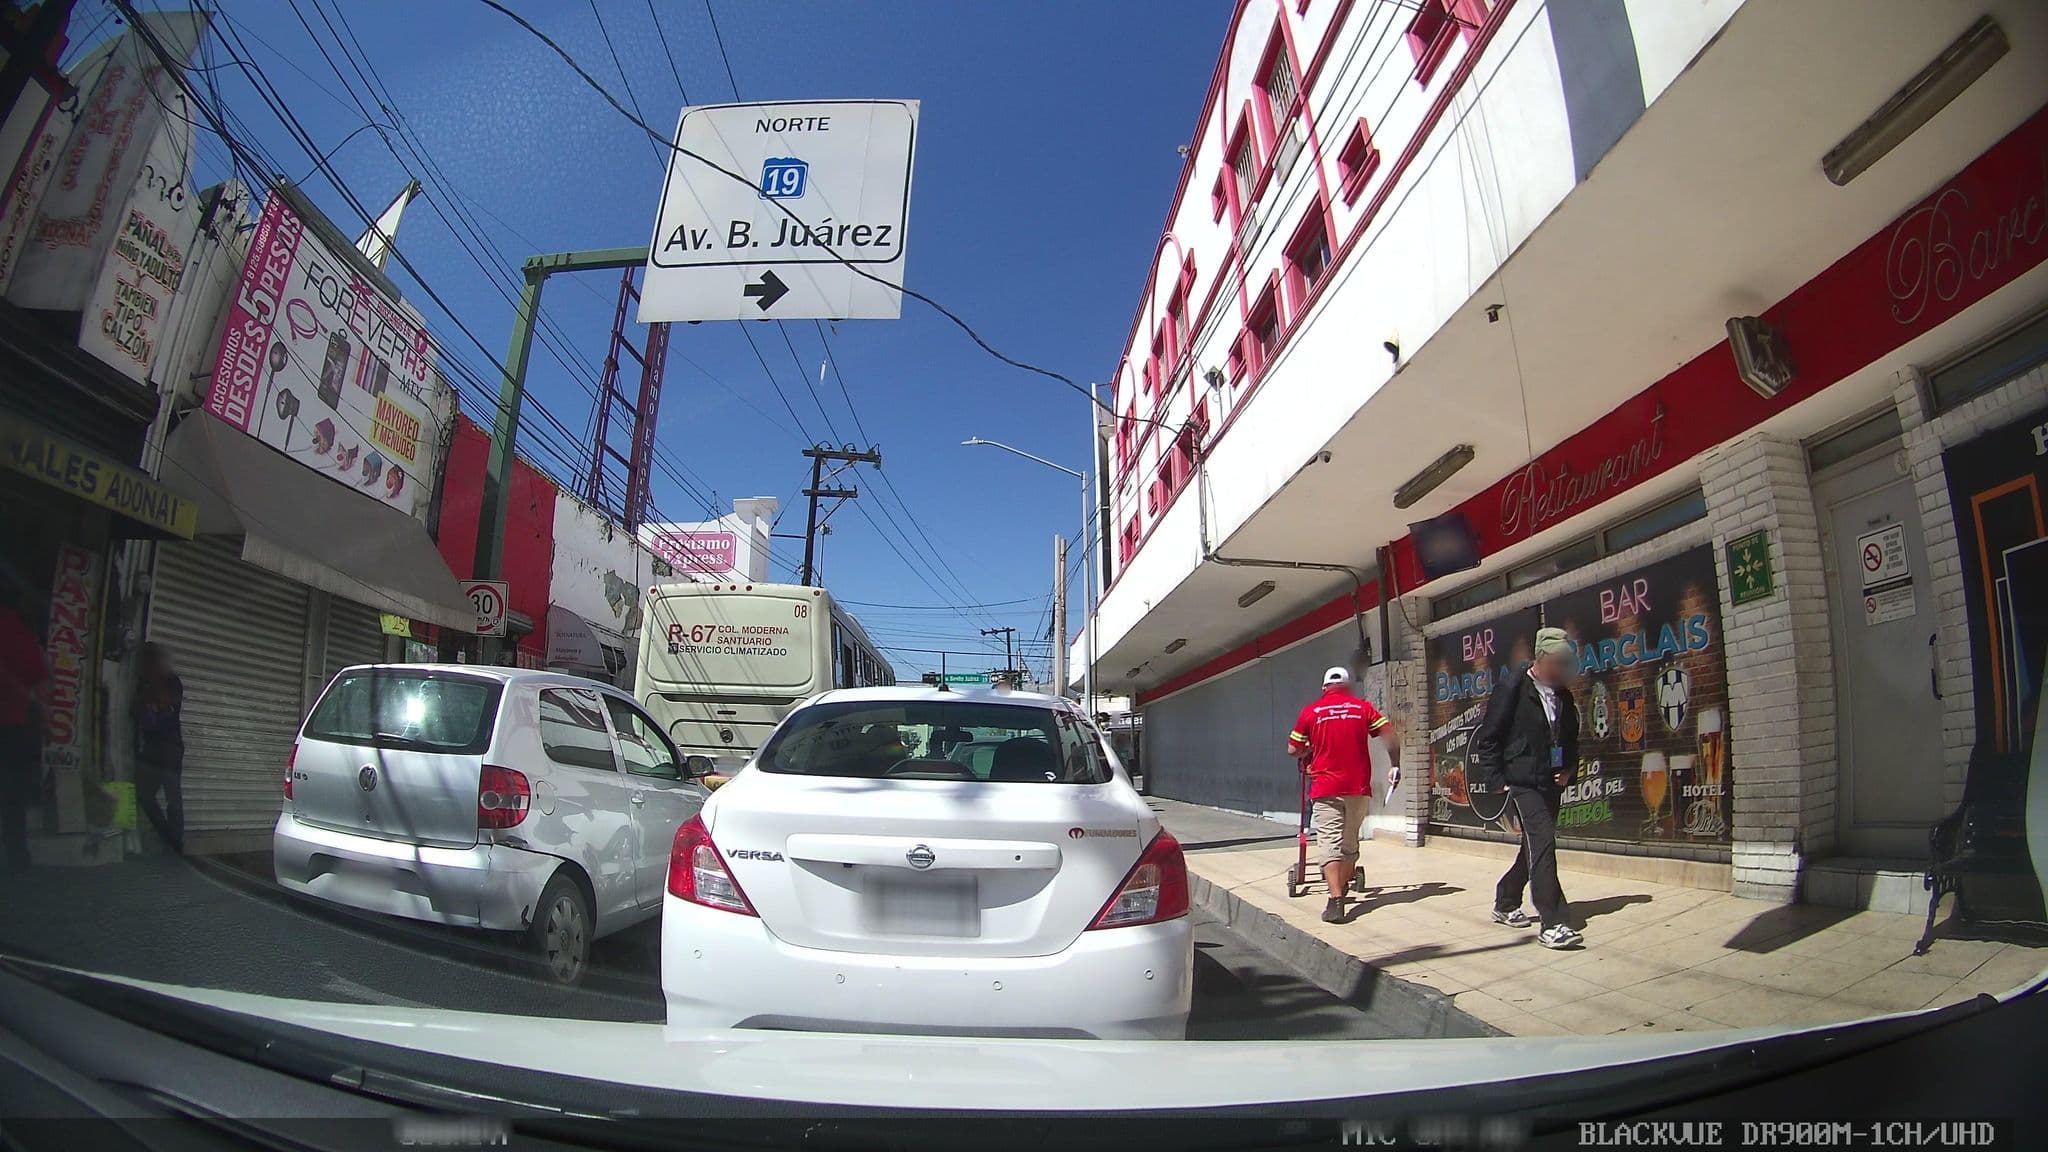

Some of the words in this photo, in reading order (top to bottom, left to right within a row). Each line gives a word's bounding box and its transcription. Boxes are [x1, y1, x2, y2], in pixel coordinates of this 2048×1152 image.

[755, 117, 831, 133] NORTE
[766, 168, 800, 195] 19
[664, 224, 713, 252] Av.
[727, 220, 759, 248] B.
[771, 218, 892, 247] Juárez
[260, 208, 302, 297] PESOS
[145, 255, 182, 292] ADULTO
[115, 302, 143, 331] TIPO
[211, 328, 242, 415] ACCESORIOS
[377, 397, 420, 442] MAYOREO
[373, 420, 380, 439] Y
[379, 425, 417, 461] MENUDEO
[1501, 400, 1665, 536] Restaurant
[105, 471, 179, 527] ADONAI
[794, 605, 808, 618] 08
[1600, 578, 1651, 625] BAR
[668, 623, 717, 643] R-67
[718, 625, 739, 634] COL.
[741, 626, 790, 635] MODERNA
[717, 636, 772, 646] SANTUARIO
[1462, 628, 1496, 662] BAR
[679, 645, 721, 654] SERVICIO
[723, 646, 788, 656] CLIMATIZADO
[1586, 760, 1600, 776] LO
[1560, 778, 1602, 805] MEJOR
[1605, 779, 1625, 796] DEL
[1682, 784, 1726, 797] HOTEL
[1557, 799, 1613, 827] FUTBOL
[726, 849, 785, 862] VERSA
